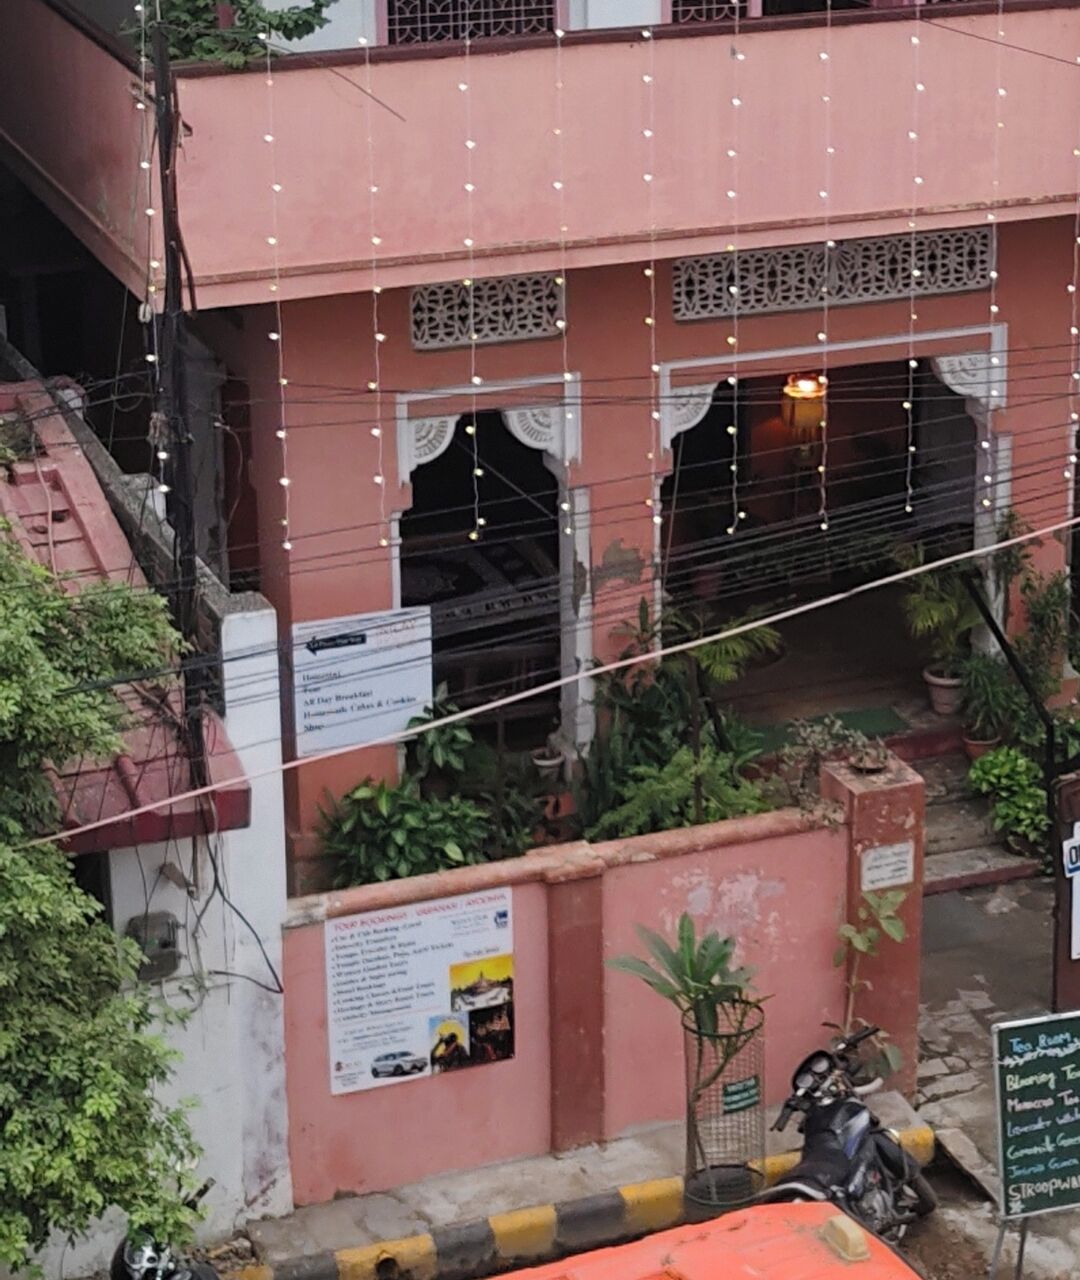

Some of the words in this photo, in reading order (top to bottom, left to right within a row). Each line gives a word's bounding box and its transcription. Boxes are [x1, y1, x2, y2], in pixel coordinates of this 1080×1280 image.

[1010, 1037, 1032, 1052] Tea
[1039, 1032, 1072, 1048] Room
[1057, 1089, 1080, 1106] Tea
